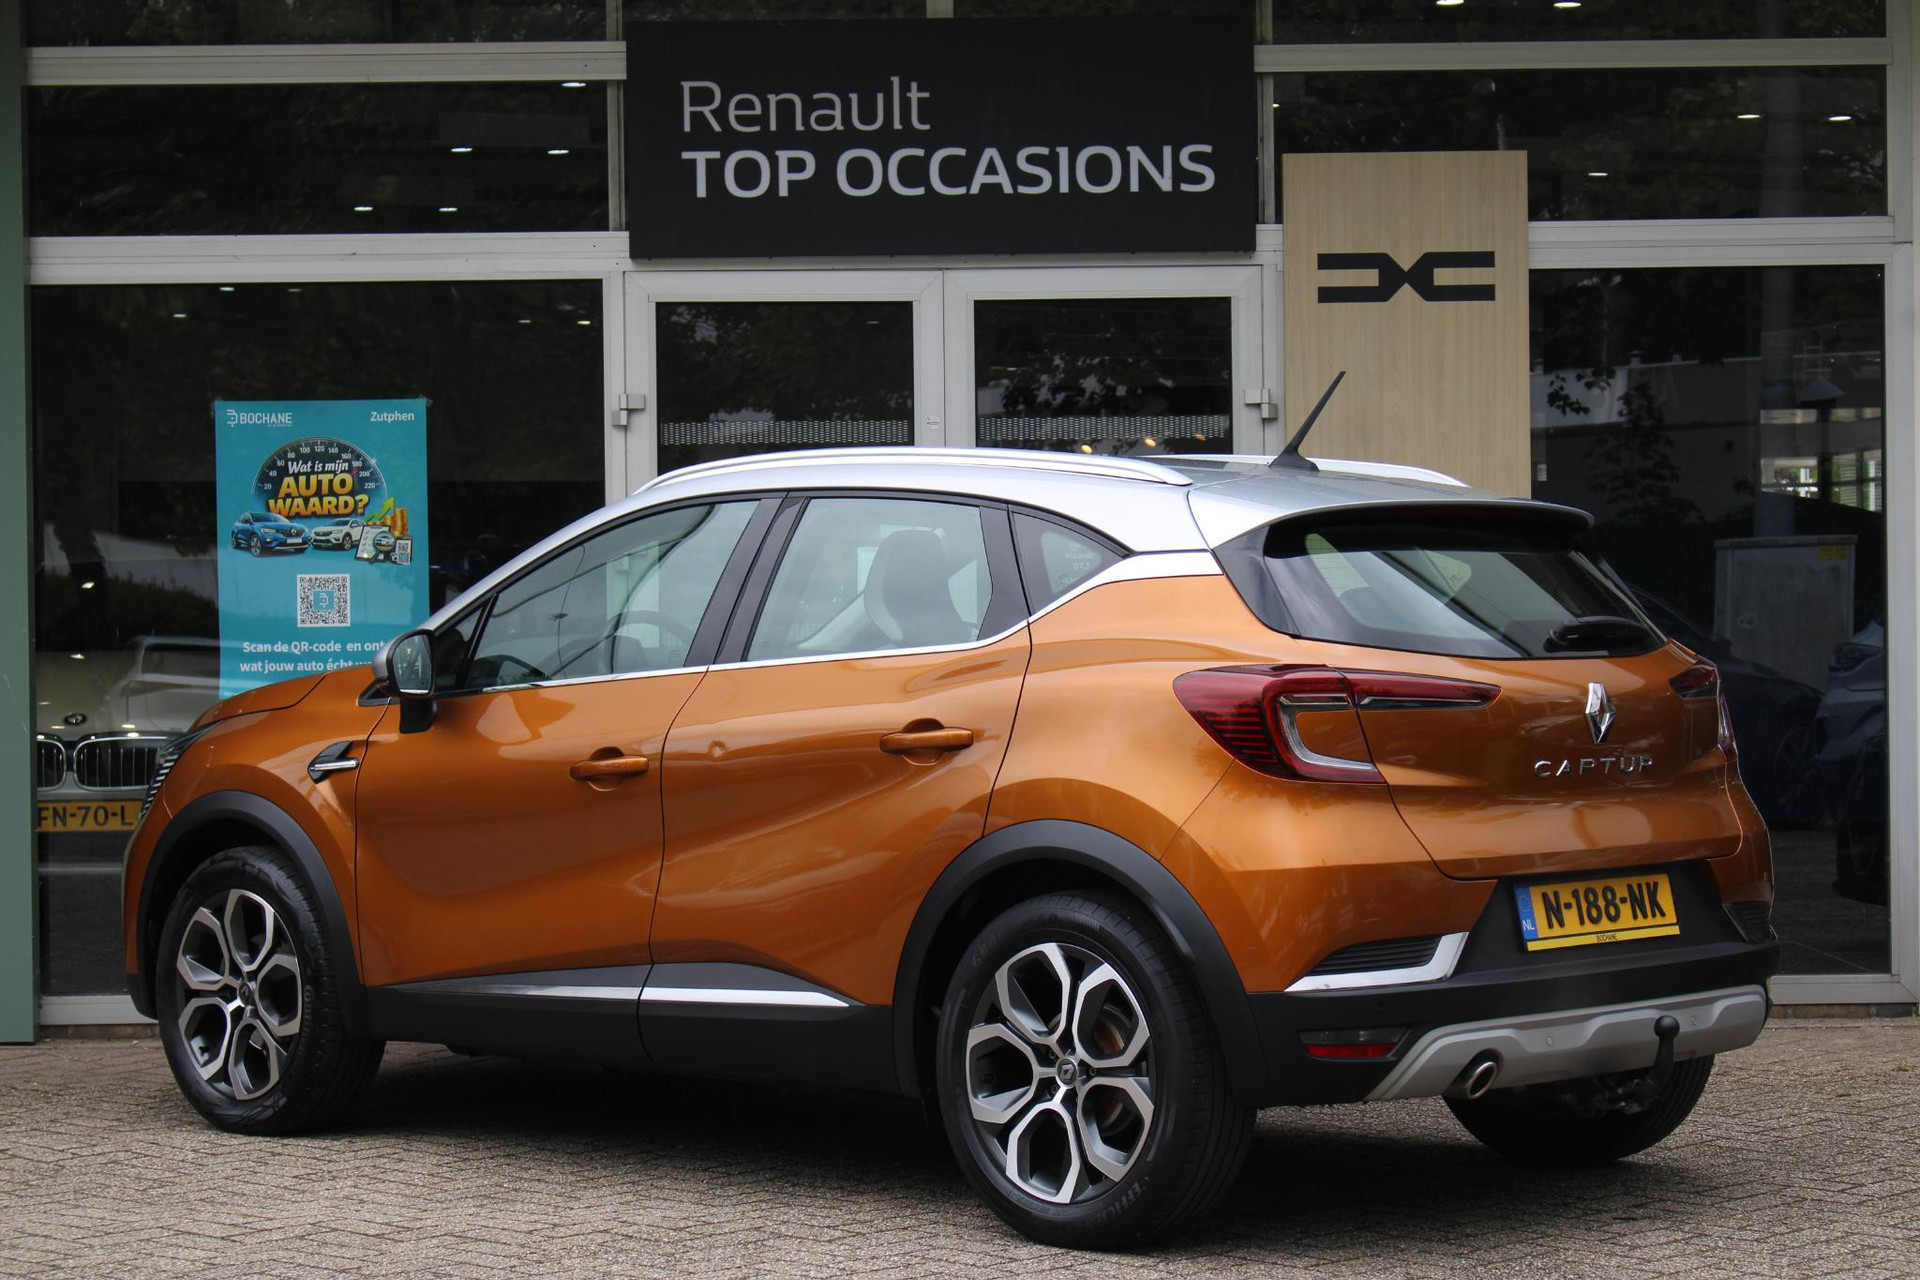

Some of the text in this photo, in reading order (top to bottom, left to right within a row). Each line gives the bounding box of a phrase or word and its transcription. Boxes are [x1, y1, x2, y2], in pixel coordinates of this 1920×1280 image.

[681, 76, 931, 132] Renault
[682, 144, 1215, 199] TOP OCCASIONS
[239, 412, 293, 424] BOCHANE
[370, 411, 415, 423] Zutphen
[287, 460, 349, 474] Wat is mijn
[278, 473, 354, 498] AUTO
[268, 494, 369, 517] WAARD?
[242, 641, 271, 653] Scan
[273, 641, 289, 653] de
[291, 640, 342, 655] QR-code
[346, 642, 361, 652] en
[240, 661, 263, 672] wat
[264, 660, 294, 674] jouw
[297, 661, 324, 671] auto
[1534, 756, 1653, 778] CAPTUR
[38, 805, 133, 827] FN-70-L
[1541, 881, 1667, 930] N-188-NK
[1522, 919, 1535, 931] NL
